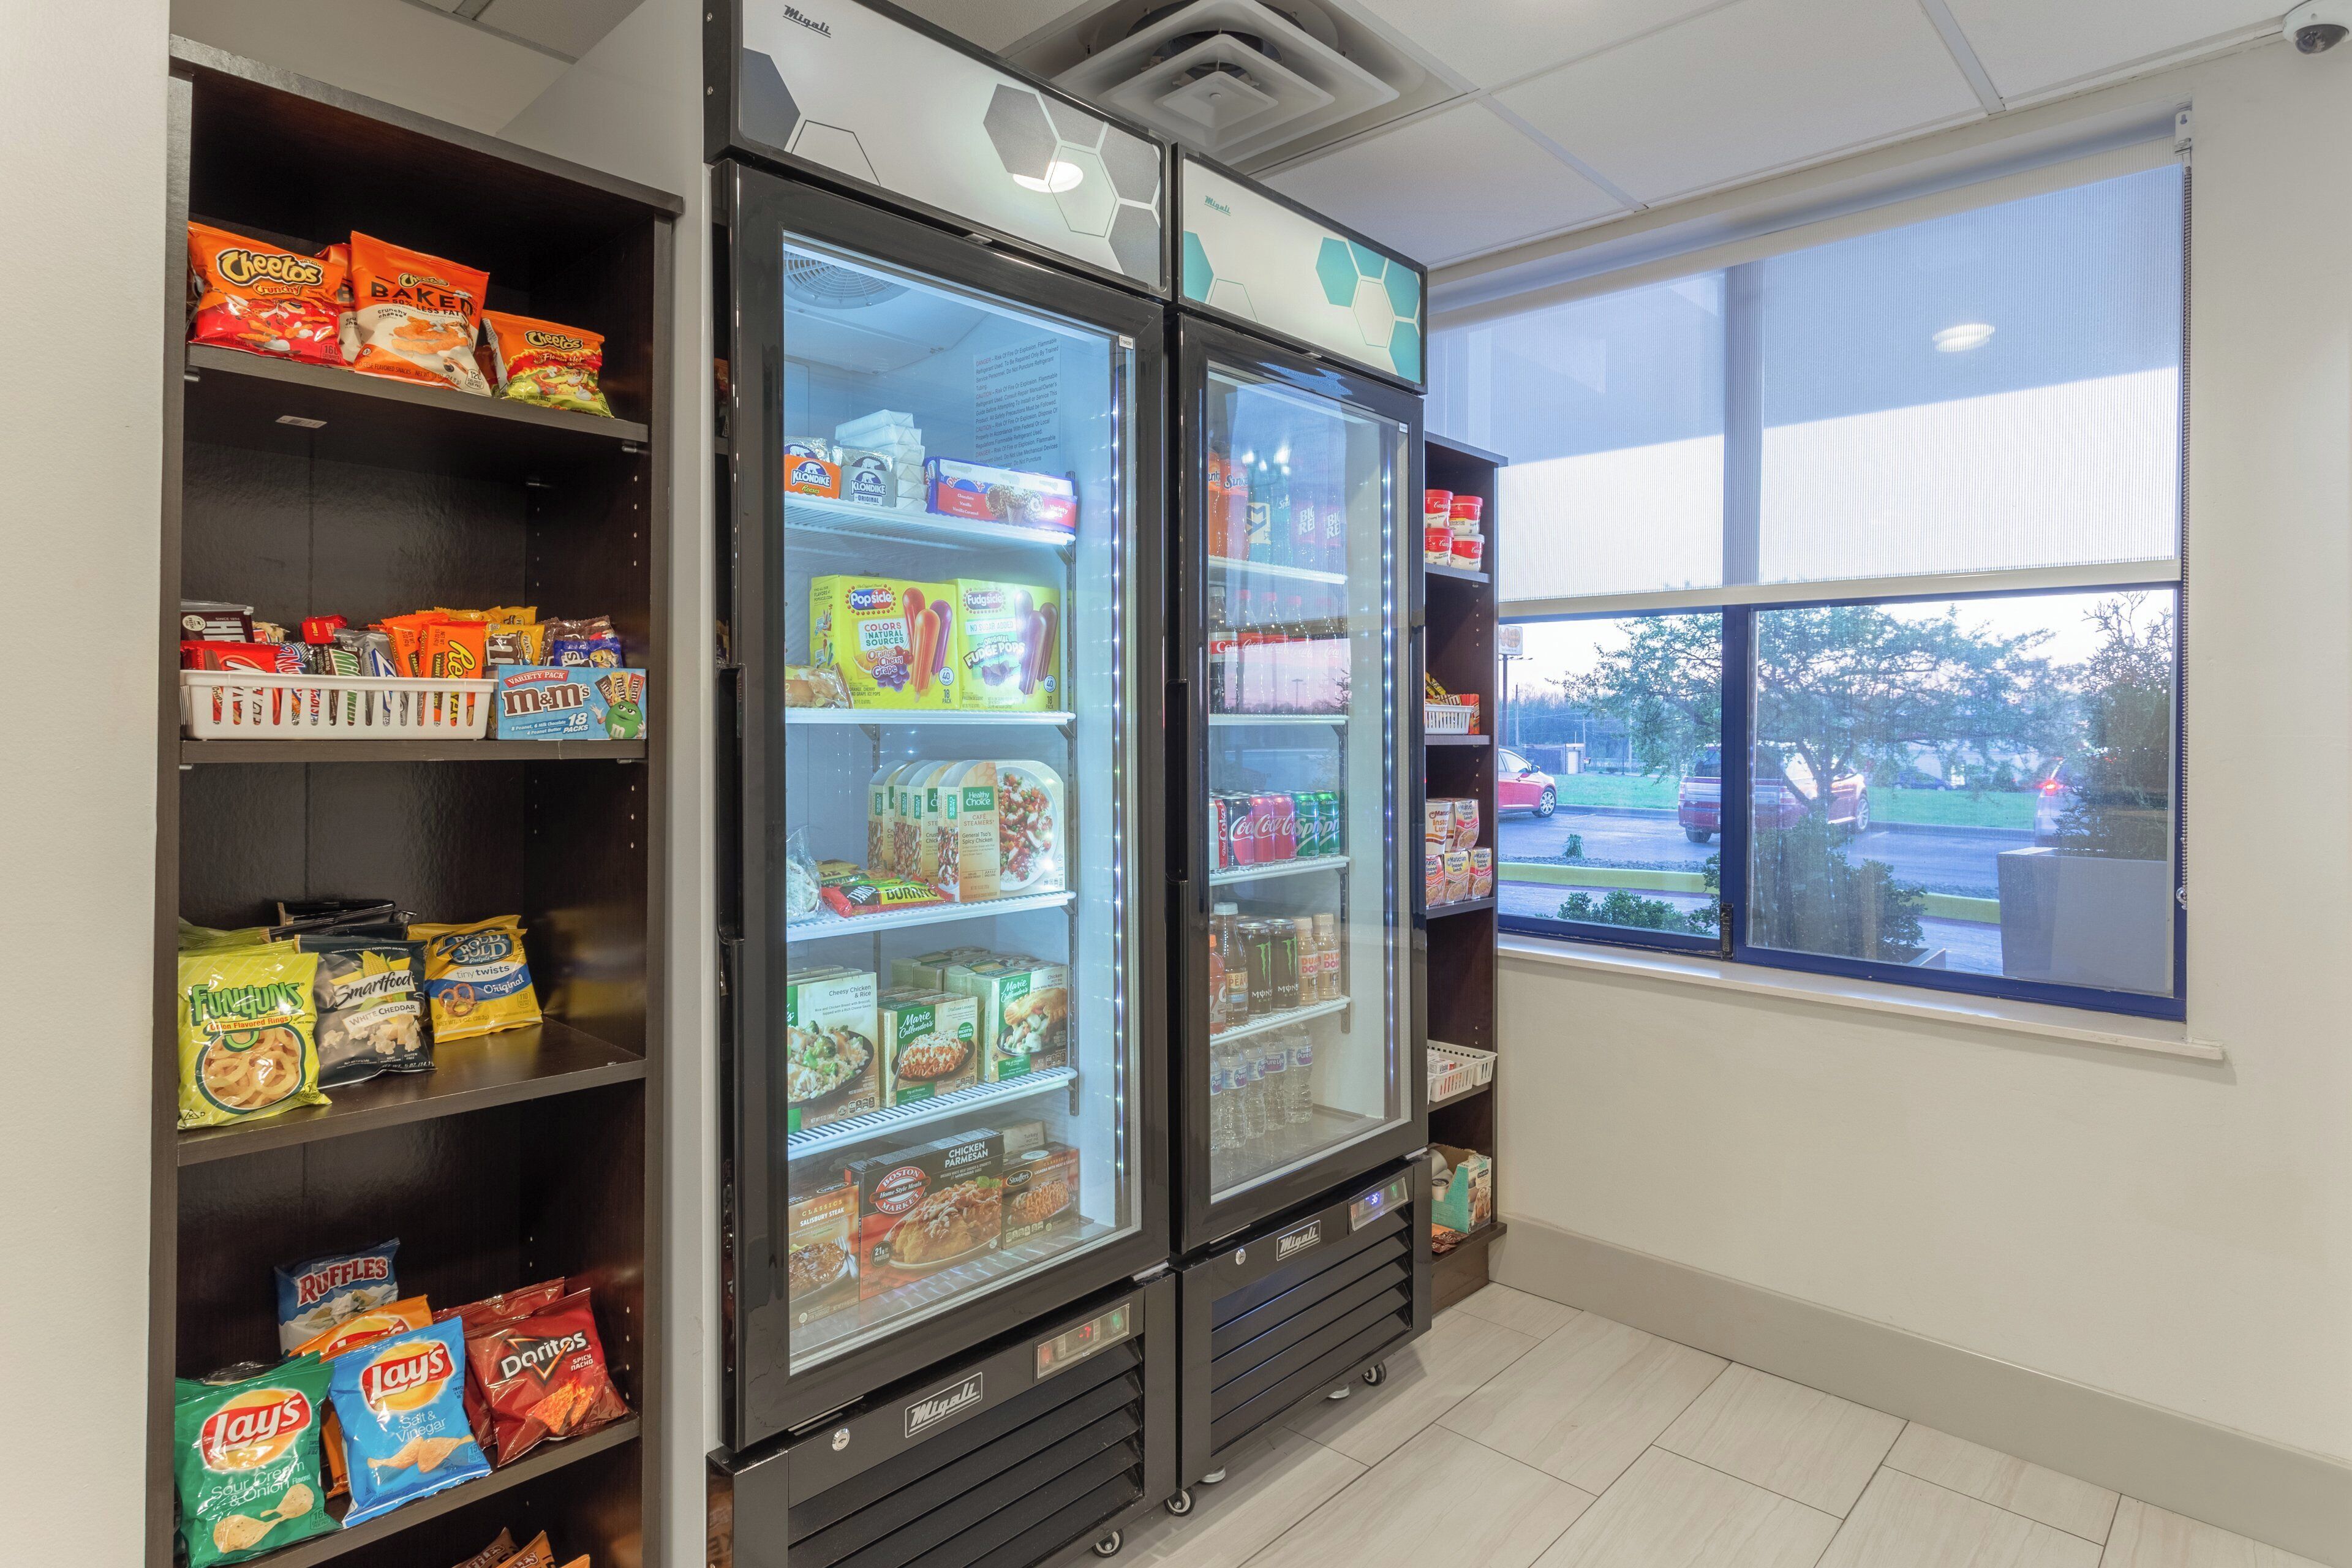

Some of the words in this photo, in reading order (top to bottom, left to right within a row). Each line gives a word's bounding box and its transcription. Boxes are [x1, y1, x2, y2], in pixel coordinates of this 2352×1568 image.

[783, 5, 832, 36] Migali
[1205, 196, 1231, 214] Migali
[217, 248, 323, 285] Cheetos
[399, 274, 450, 288] Cheetos
[253, 284, 302, 295] Crunchy
[371, 281, 473, 317] BAKED
[392, 298, 413, 307] 50%
[417, 304, 440, 314] LESS
[377, 308, 407, 317] crunchy
[526, 331, 583, 350] Cheetos
[976, 358, 991, 366] DANGER
[1038, 338, 1057, 348] Flammable
[976, 365, 993, 375] Refrigerant
[1015, 355, 1030, 364] Repaired
[1046, 345, 1059, 354] Trained
[374, 363, 395, 373] FLAVORED
[396, 366, 412, 375] SNACKS
[1019, 362, 1034, 371] Puncture
[1035, 356, 1054, 366] Refrigerant
[792, 470, 831, 488] KLONDIKE
[851, 481, 886, 495] KLONDIKE
[1050, 504, 1068, 514] Variety
[850, 591, 892, 606] Popsicle
[967, 594, 1003, 607] Fudgsicle
[864, 622, 902, 632] COLORS
[869, 630, 903, 639] NATURAL
[979, 622, 995, 631] SUGAR
[866, 637, 904, 646] SOURCES
[984, 635, 1009, 644] ORIGINAL
[867, 648, 897, 660] Orange
[878, 655, 903, 666] Cherry
[963, 645, 998, 669] FUDGE
[998, 641, 1025, 654] POPS
[508, 673, 541, 685] VARIETY
[872, 665, 897, 678] Grape
[943, 689, 949, 698] 18
[568, 713, 587, 726] 18
[562, 725, 589, 734] PACKS
[968, 792, 990, 801] Healthy
[452, 942, 507, 963] GOLD
[469, 955, 490, 964] Pretzels
[457, 970, 475, 979] tiny
[475, 965, 510, 976] twists
[334, 971, 412, 1008] Smartfood
[483, 974, 524, 995] Original
[829, 988, 848, 997] Cheesy
[850, 985, 871, 993] Chicken
[1001, 979, 1027, 995] Marie
[1001, 987, 1029, 1003] Callender's
[191, 982, 304, 1026] FUNYUNS
[210, 1022, 232, 1031] Onion
[233, 1018, 266, 1030] Flavored
[267, 1015, 289, 1027] Rings
[349, 1011, 378, 1025] WHITE
[379, 1005, 416, 1015] CHEDDAR
[900, 1011, 932, 1029] Marie
[899, 1021, 934, 1039] Callender's
[949, 1141, 985, 1159] CHICKEN
[944, 1149, 989, 1169] PARMESAN
[882, 1168, 920, 1188] BOSTON
[1008, 1171, 1030, 1184] Stouffer's
[1034, 1167, 1048, 1175] LASAGNA
[895, 1186, 907, 1194] Style
[802, 1199, 843, 1217] CLASSICS
[882, 1193, 920, 1212] MARKET
[800, 1212, 827, 1227] SALISBURY
[829, 1207, 845, 1217] STEAK
[1280, 1226, 1318, 1254] Migali
[874, 1253, 889, 1262] PROTEIN
[875, 1246, 884, 1256] 21g
[297, 1256, 388, 1307] RUFFLES
[500, 1331, 587, 1379] Doritos
[572, 1353, 592, 1365] SPICY
[370, 1344, 445, 1401] Lay's
[571, 1358, 594, 1371] NACHO
[910, 1381, 980, 1428] Migali
[210, 1396, 304, 1452] Lay's
[402, 1412, 426, 1429] Salt
[428, 1411, 437, 1421] &
[396, 1417, 447, 1443] Vinegar
[211, 1477, 249, 1499] Sour
[254, 1461, 305, 1485] Cream
[230, 1494, 243, 1508] &
[244, 1480, 290, 1502] Onion
[292, 1474, 311, 1484] Flavored
